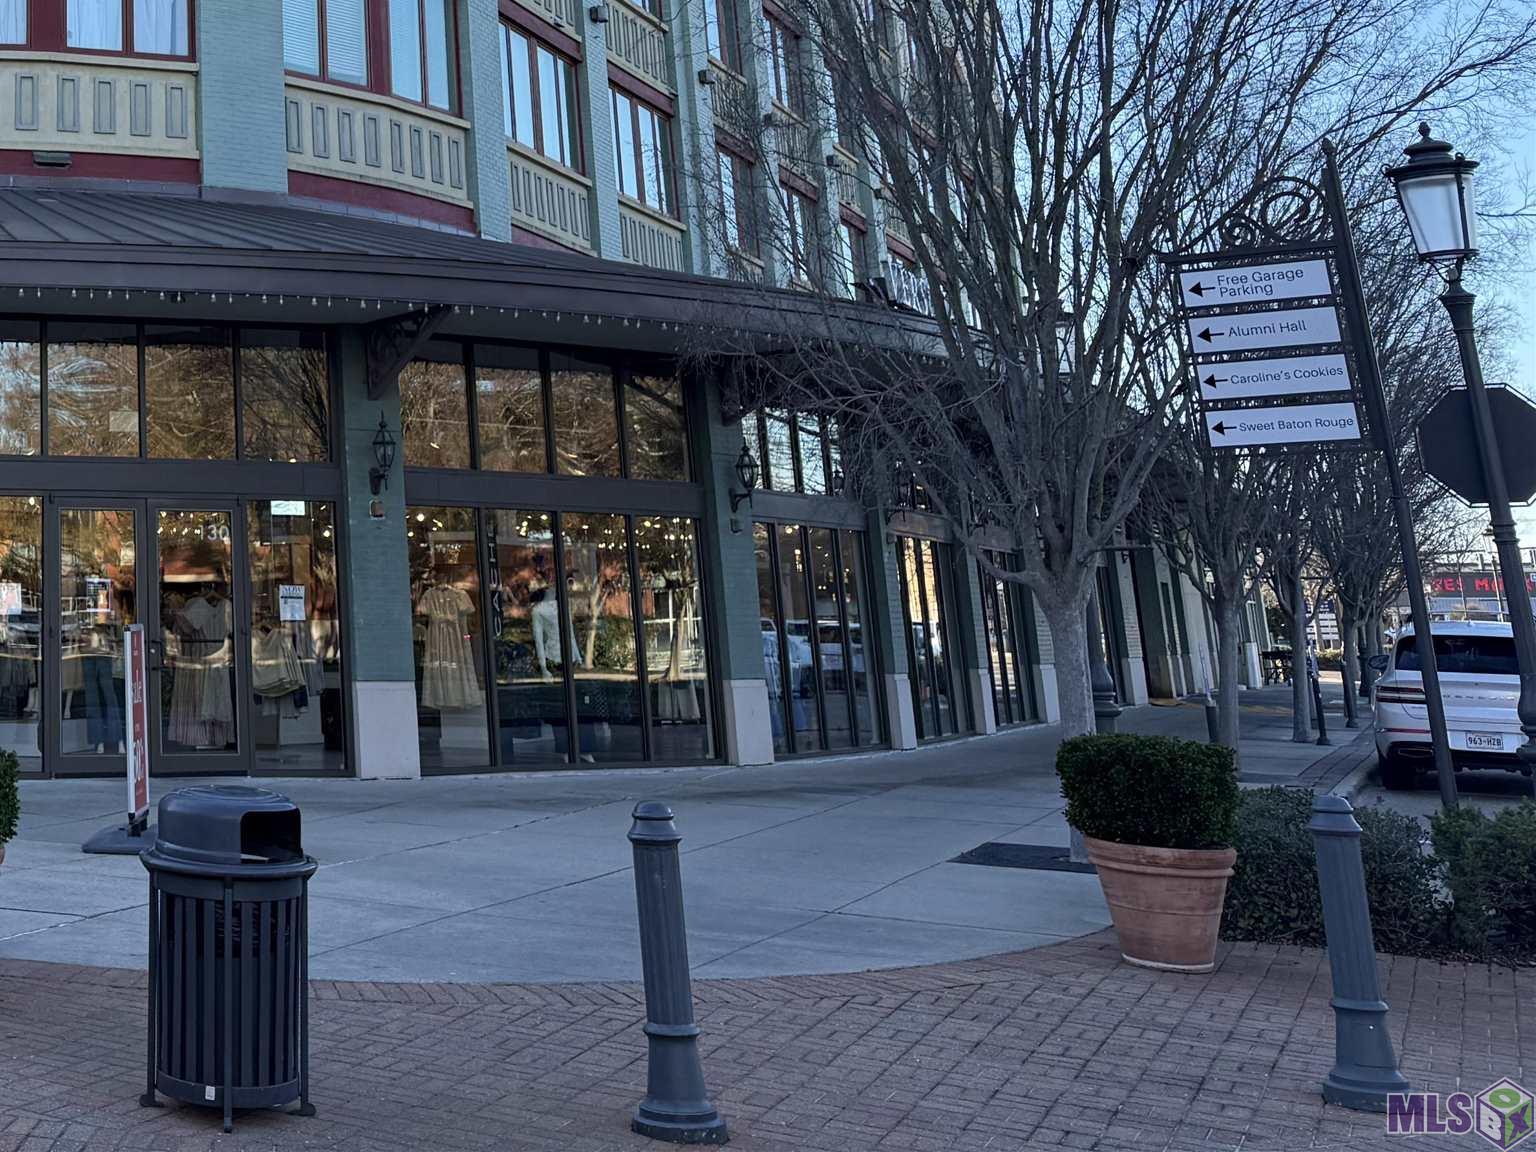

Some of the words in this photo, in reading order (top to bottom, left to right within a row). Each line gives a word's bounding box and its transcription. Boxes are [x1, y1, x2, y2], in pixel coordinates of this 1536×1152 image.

[1217, 274, 1248, 286] Free
[1251, 269, 1304, 282] Garage
[1219, 284, 1274, 298] Parking
[1228, 322, 1275, 338] Alumni
[1279, 320, 1307, 333] Hall
[1230, 370, 1290, 385] Caroline's
[1293, 366, 1344, 379] Cookies
[1239, 421, 1275, 432] Sweet
[1278, 419, 1312, 430] Baton
[1315, 417, 1354, 429] Rouge
